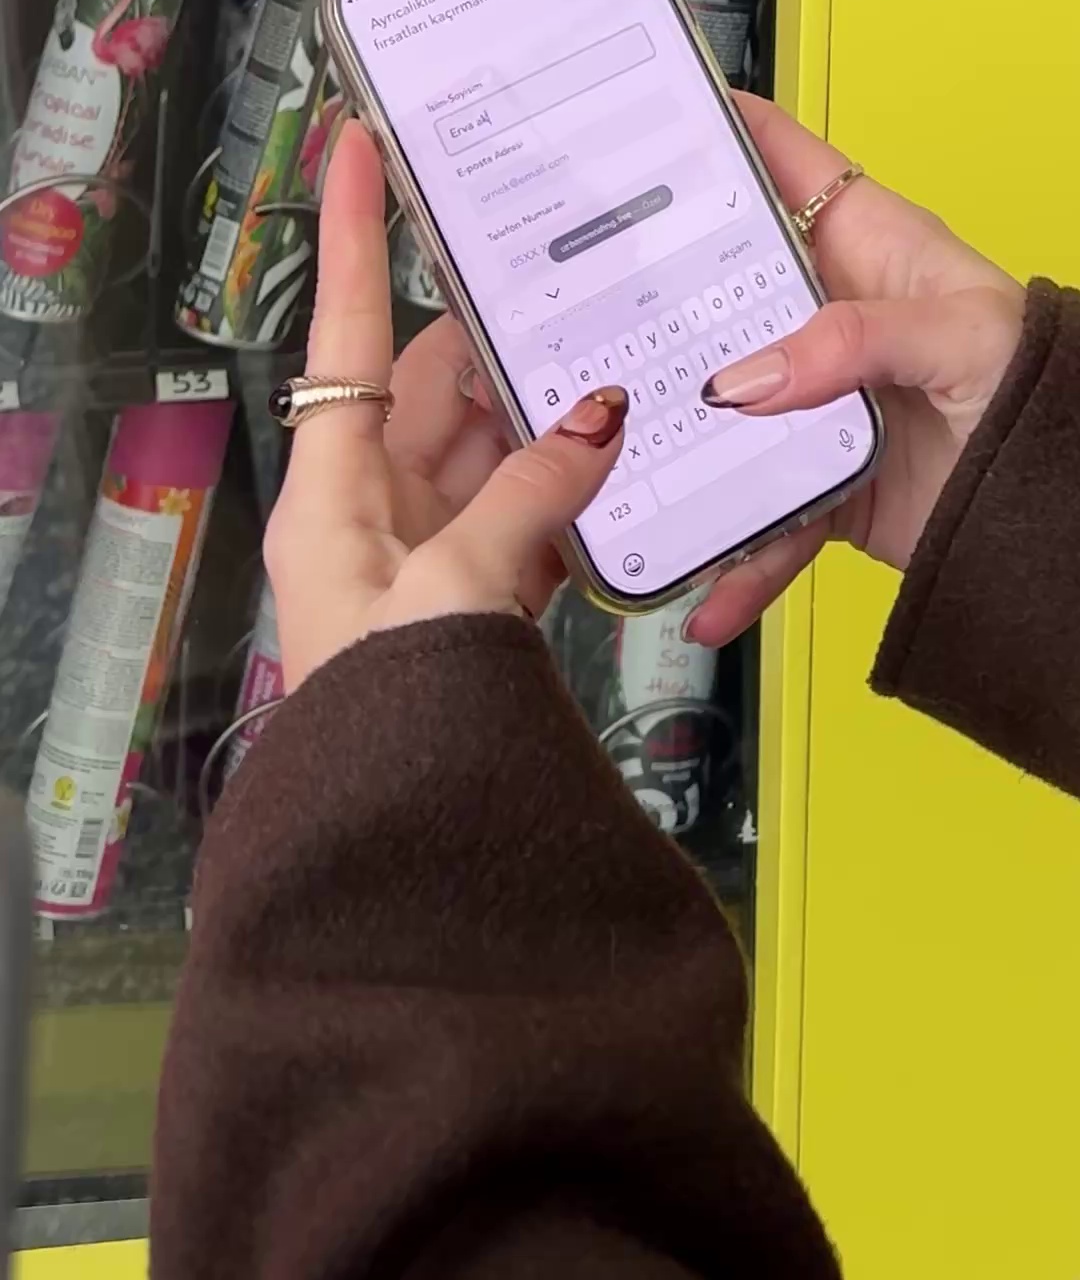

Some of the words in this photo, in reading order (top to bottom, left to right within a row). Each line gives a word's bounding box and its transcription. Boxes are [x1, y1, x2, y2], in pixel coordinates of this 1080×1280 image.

[373, 21, 429, 51] fırsatları
[449, 122, 475, 139] Erva
[456, 155, 494, 178] E-posta
[486, 222, 523, 242] Telefon
[718, 239, 753, 264] akşam
[579, 369, 591, 383] e
[603, 356, 611, 370] r
[624, 344, 635, 358] t
[646, 332, 657, 349] y
[668, 320, 681, 334] u
[711, 297, 724, 309] o
[733, 284, 745, 301] p
[754, 272, 768, 290] ğ
[775, 261, 787, 276] ü
[544, 387, 561, 407] a
[633, 388, 642, 405] f
[654, 379, 668, 396] g
[675, 366, 689, 381] h
[700, 352, 709, 370] j
[719, 341, 732, 357] k
[763, 320, 775, 335] ş
[172, 371, 212, 394] 53
[628, 445, 641, 459] x
[652, 433, 664, 446] c
[672, 421, 684, 433] v
[694, 407, 708, 421] b
[608, 502, 633, 523] 123
